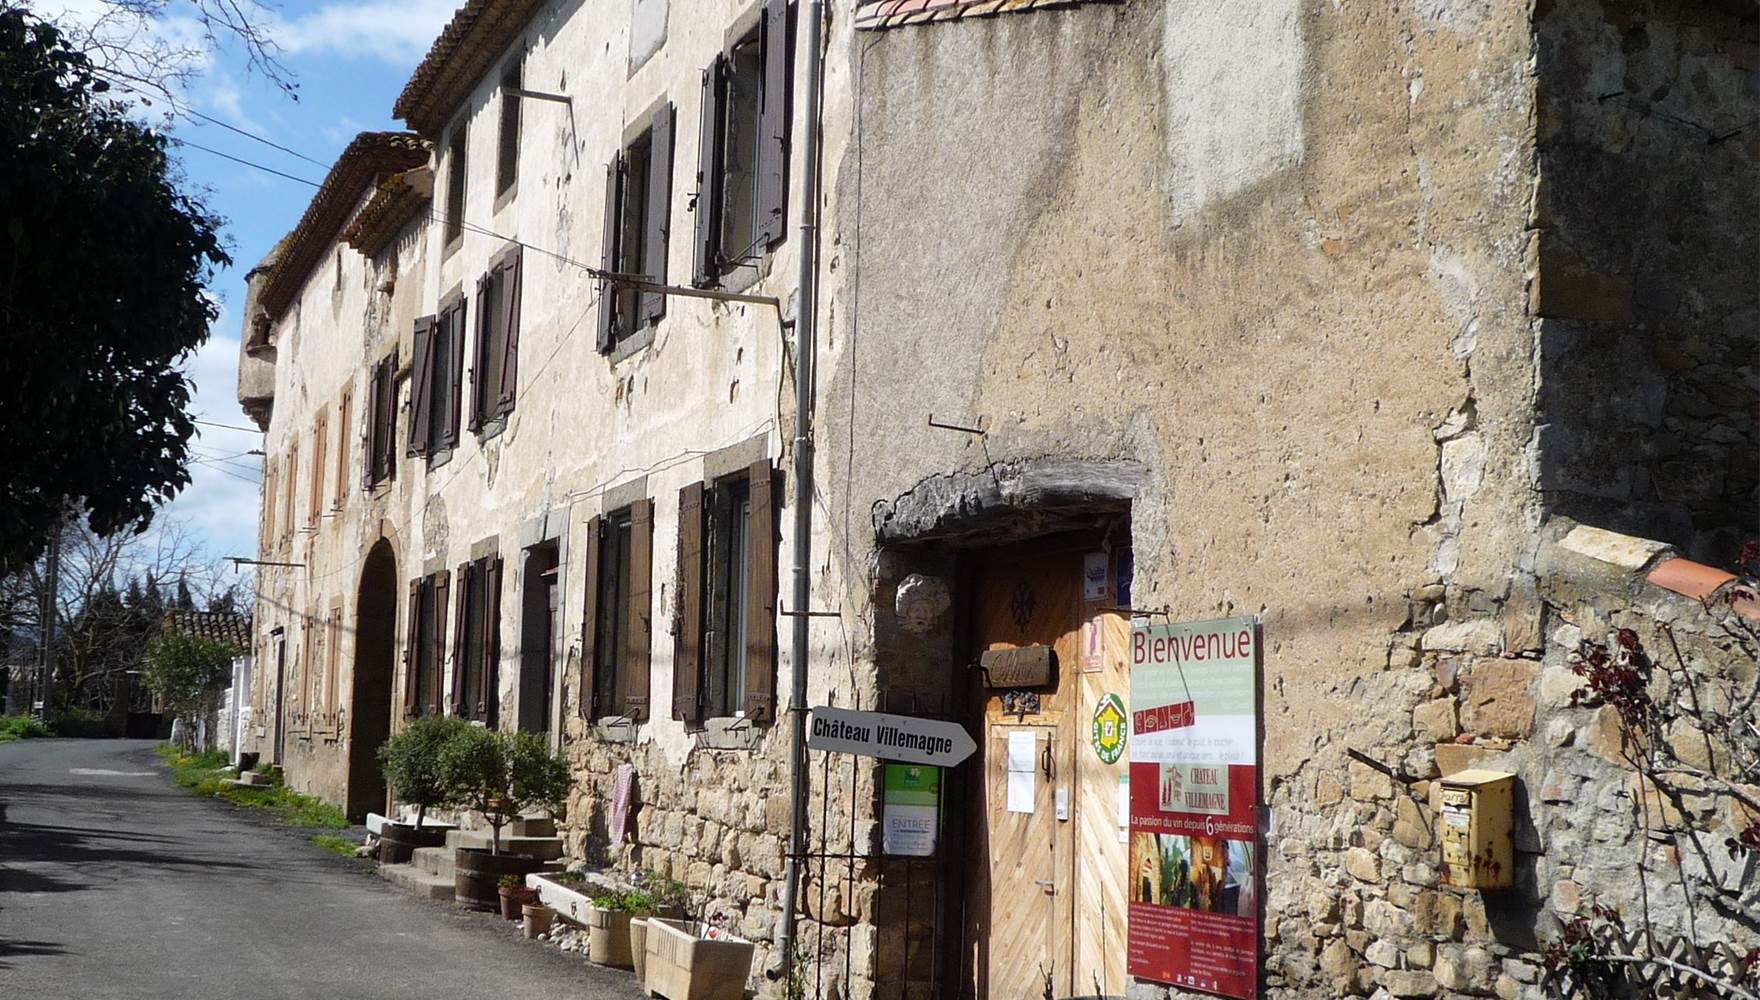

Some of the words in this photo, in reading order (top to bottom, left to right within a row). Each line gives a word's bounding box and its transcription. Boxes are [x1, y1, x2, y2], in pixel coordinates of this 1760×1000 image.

[1134, 630, 1251, 665] Bienvenue
[813, 717, 871, 743] Château
[876, 725, 953, 756] Villemagne
[1101, 750, 1111, 762] DE
[1111, 722, 1126, 760] FRANCE
[1184, 791, 1226, 811] VILLEMAGNE
[1131, 814, 1139, 825] La
[1139, 816, 1162, 828] passion
[1163, 816, 1172, 828] du
[1172, 817, 1184, 828] vin
[1184, 818, 1206, 832] depuis
[1206, 815, 1214, 836] 6
[1214, 820, 1254, 834] générations
